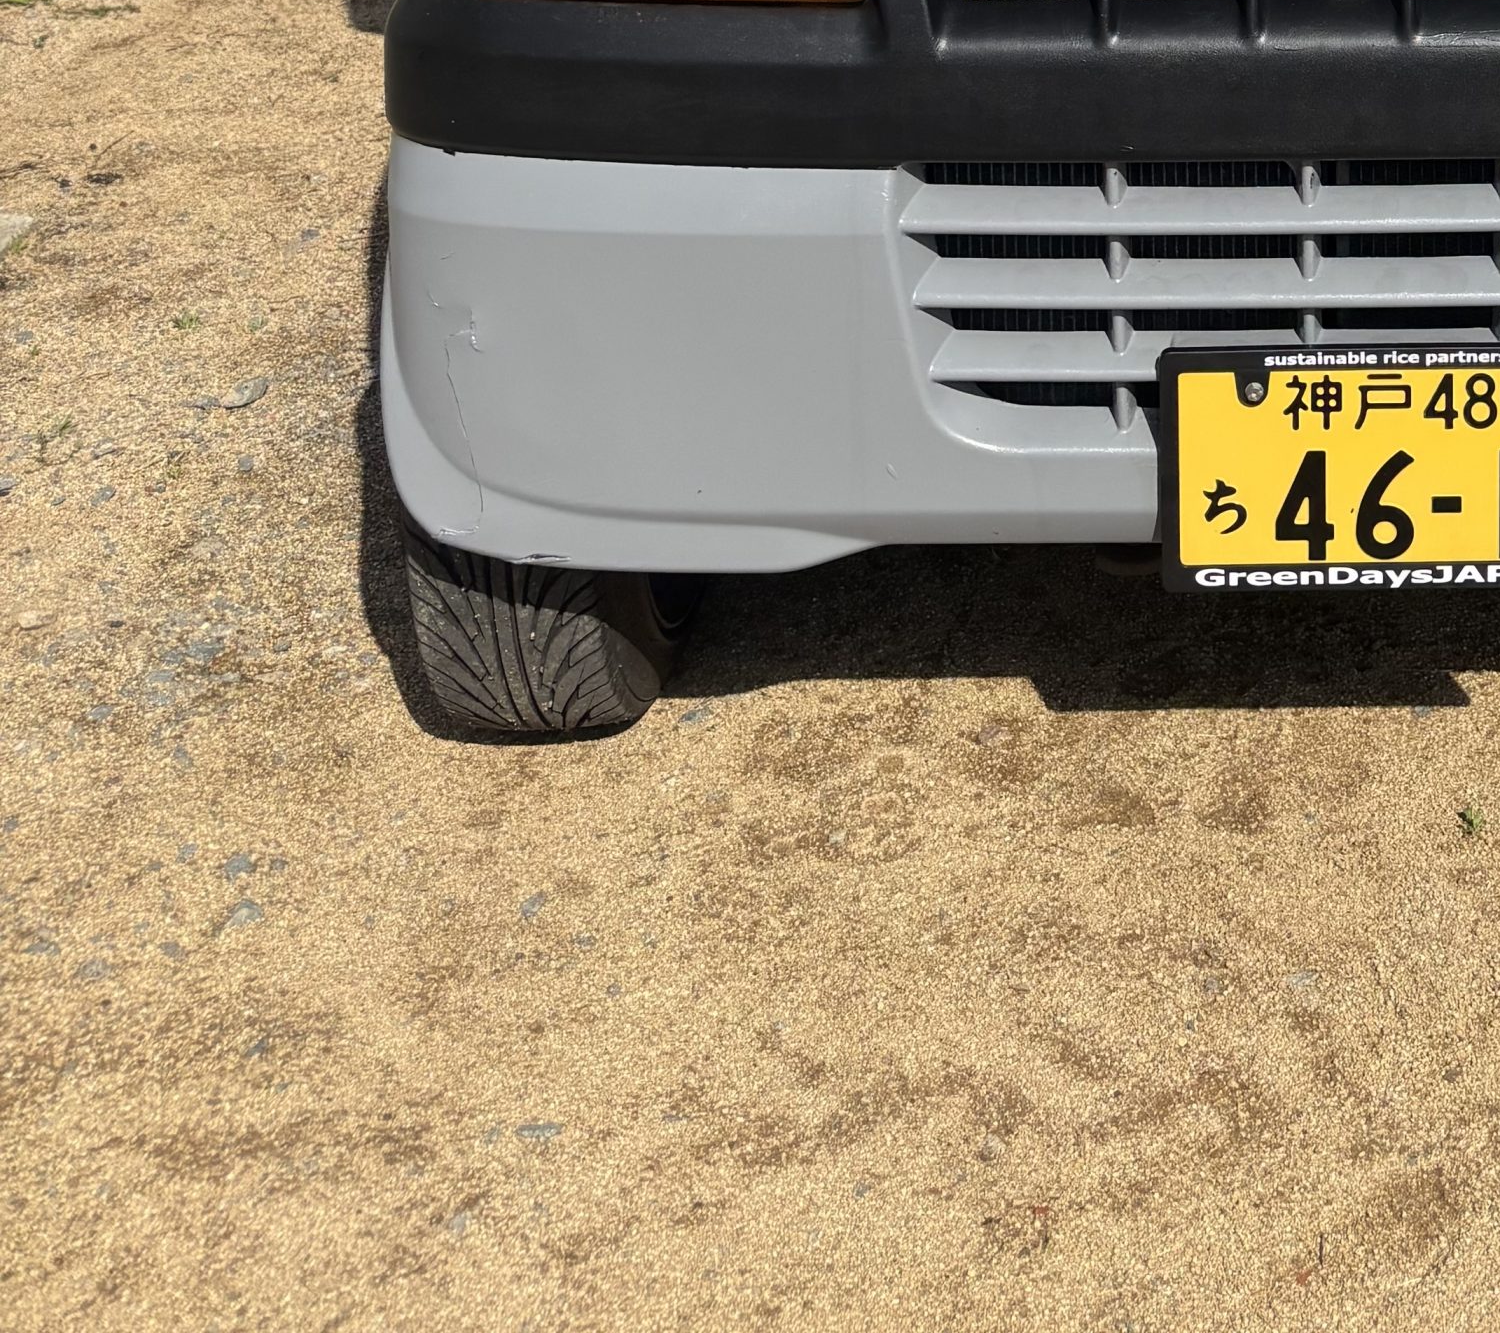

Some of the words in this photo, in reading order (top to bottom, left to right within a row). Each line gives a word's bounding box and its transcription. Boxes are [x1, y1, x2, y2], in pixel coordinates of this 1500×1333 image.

[1264, 351, 1378, 367] sustainable
[1383, 351, 1420, 365] rice
[1202, 478, 1248, 535] ち
